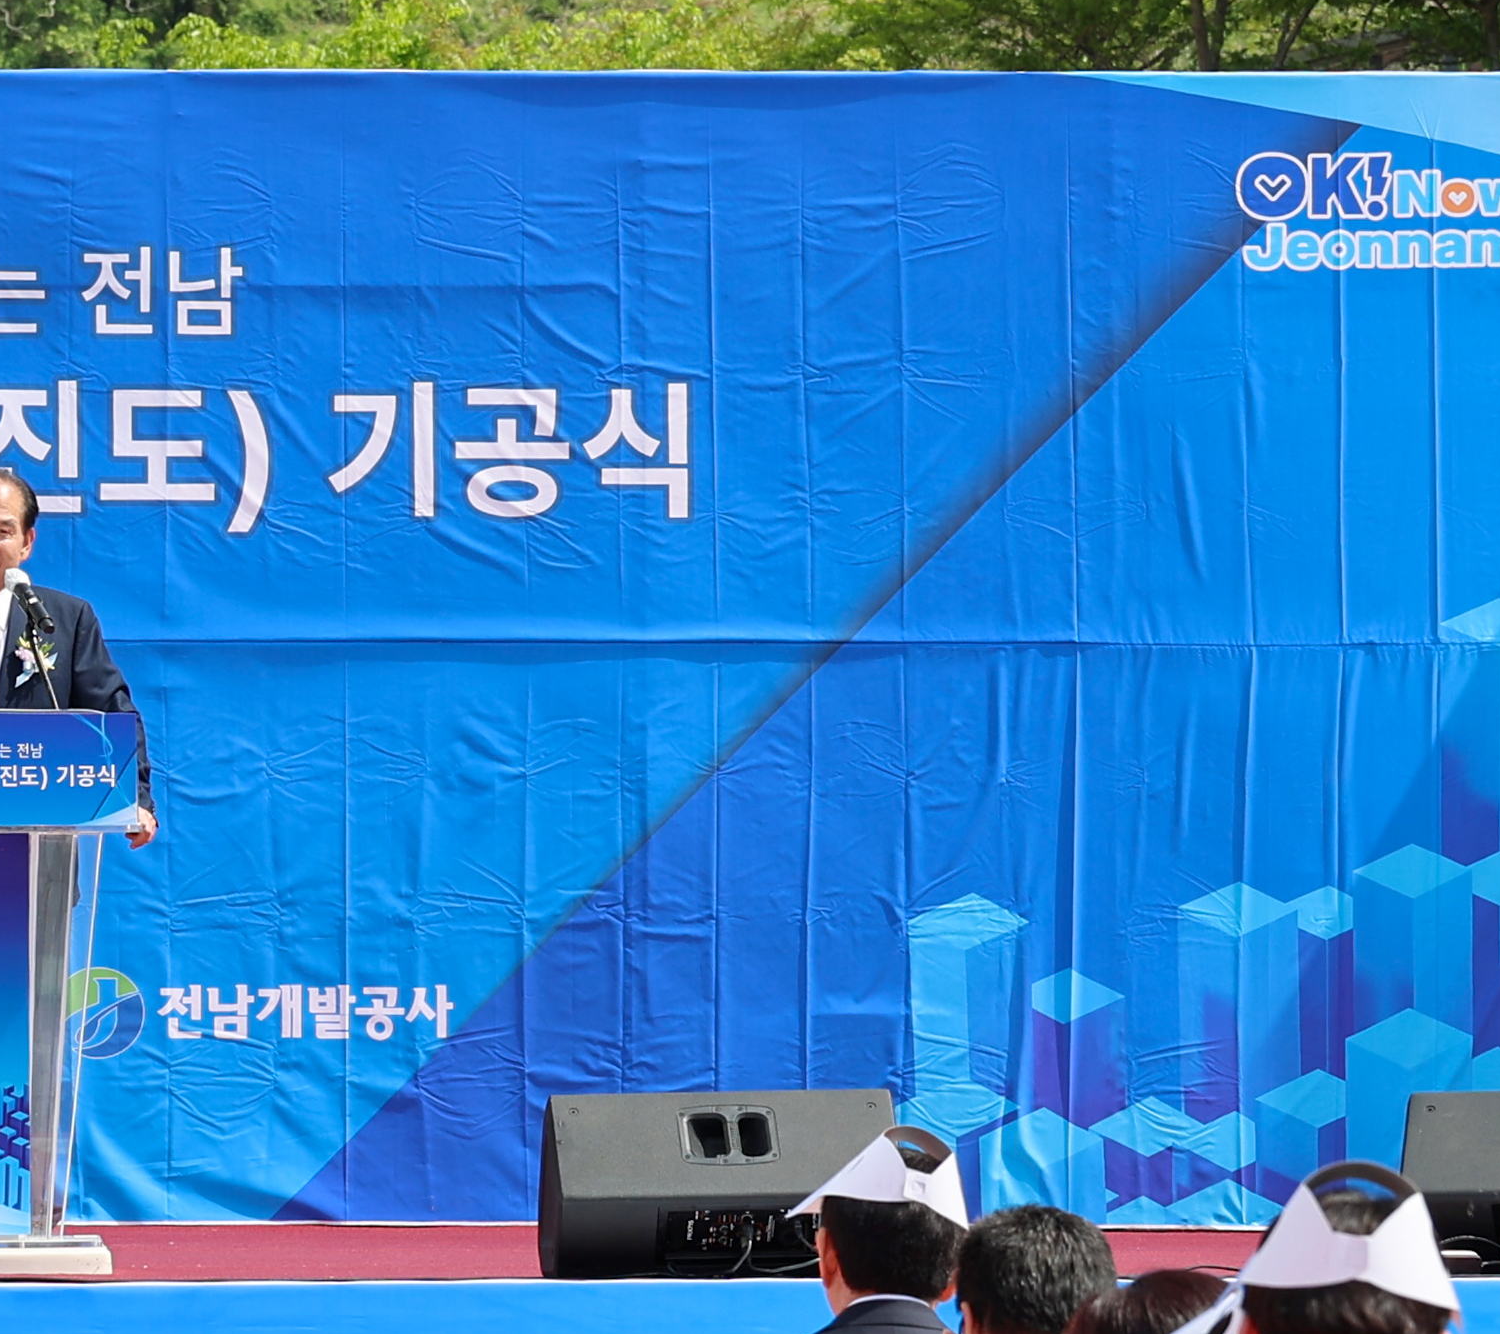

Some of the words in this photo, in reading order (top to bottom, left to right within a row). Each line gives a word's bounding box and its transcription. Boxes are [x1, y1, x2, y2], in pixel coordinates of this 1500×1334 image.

[1236, 152, 1392, 222] OK!
[82, 247, 242, 335] 전남
[329, 382, 688, 518] 기공식
[17, 742, 44, 759] 전남
[56, 764, 116, 788] 기공식
[157, 985, 454, 1040] 전남개발공사
